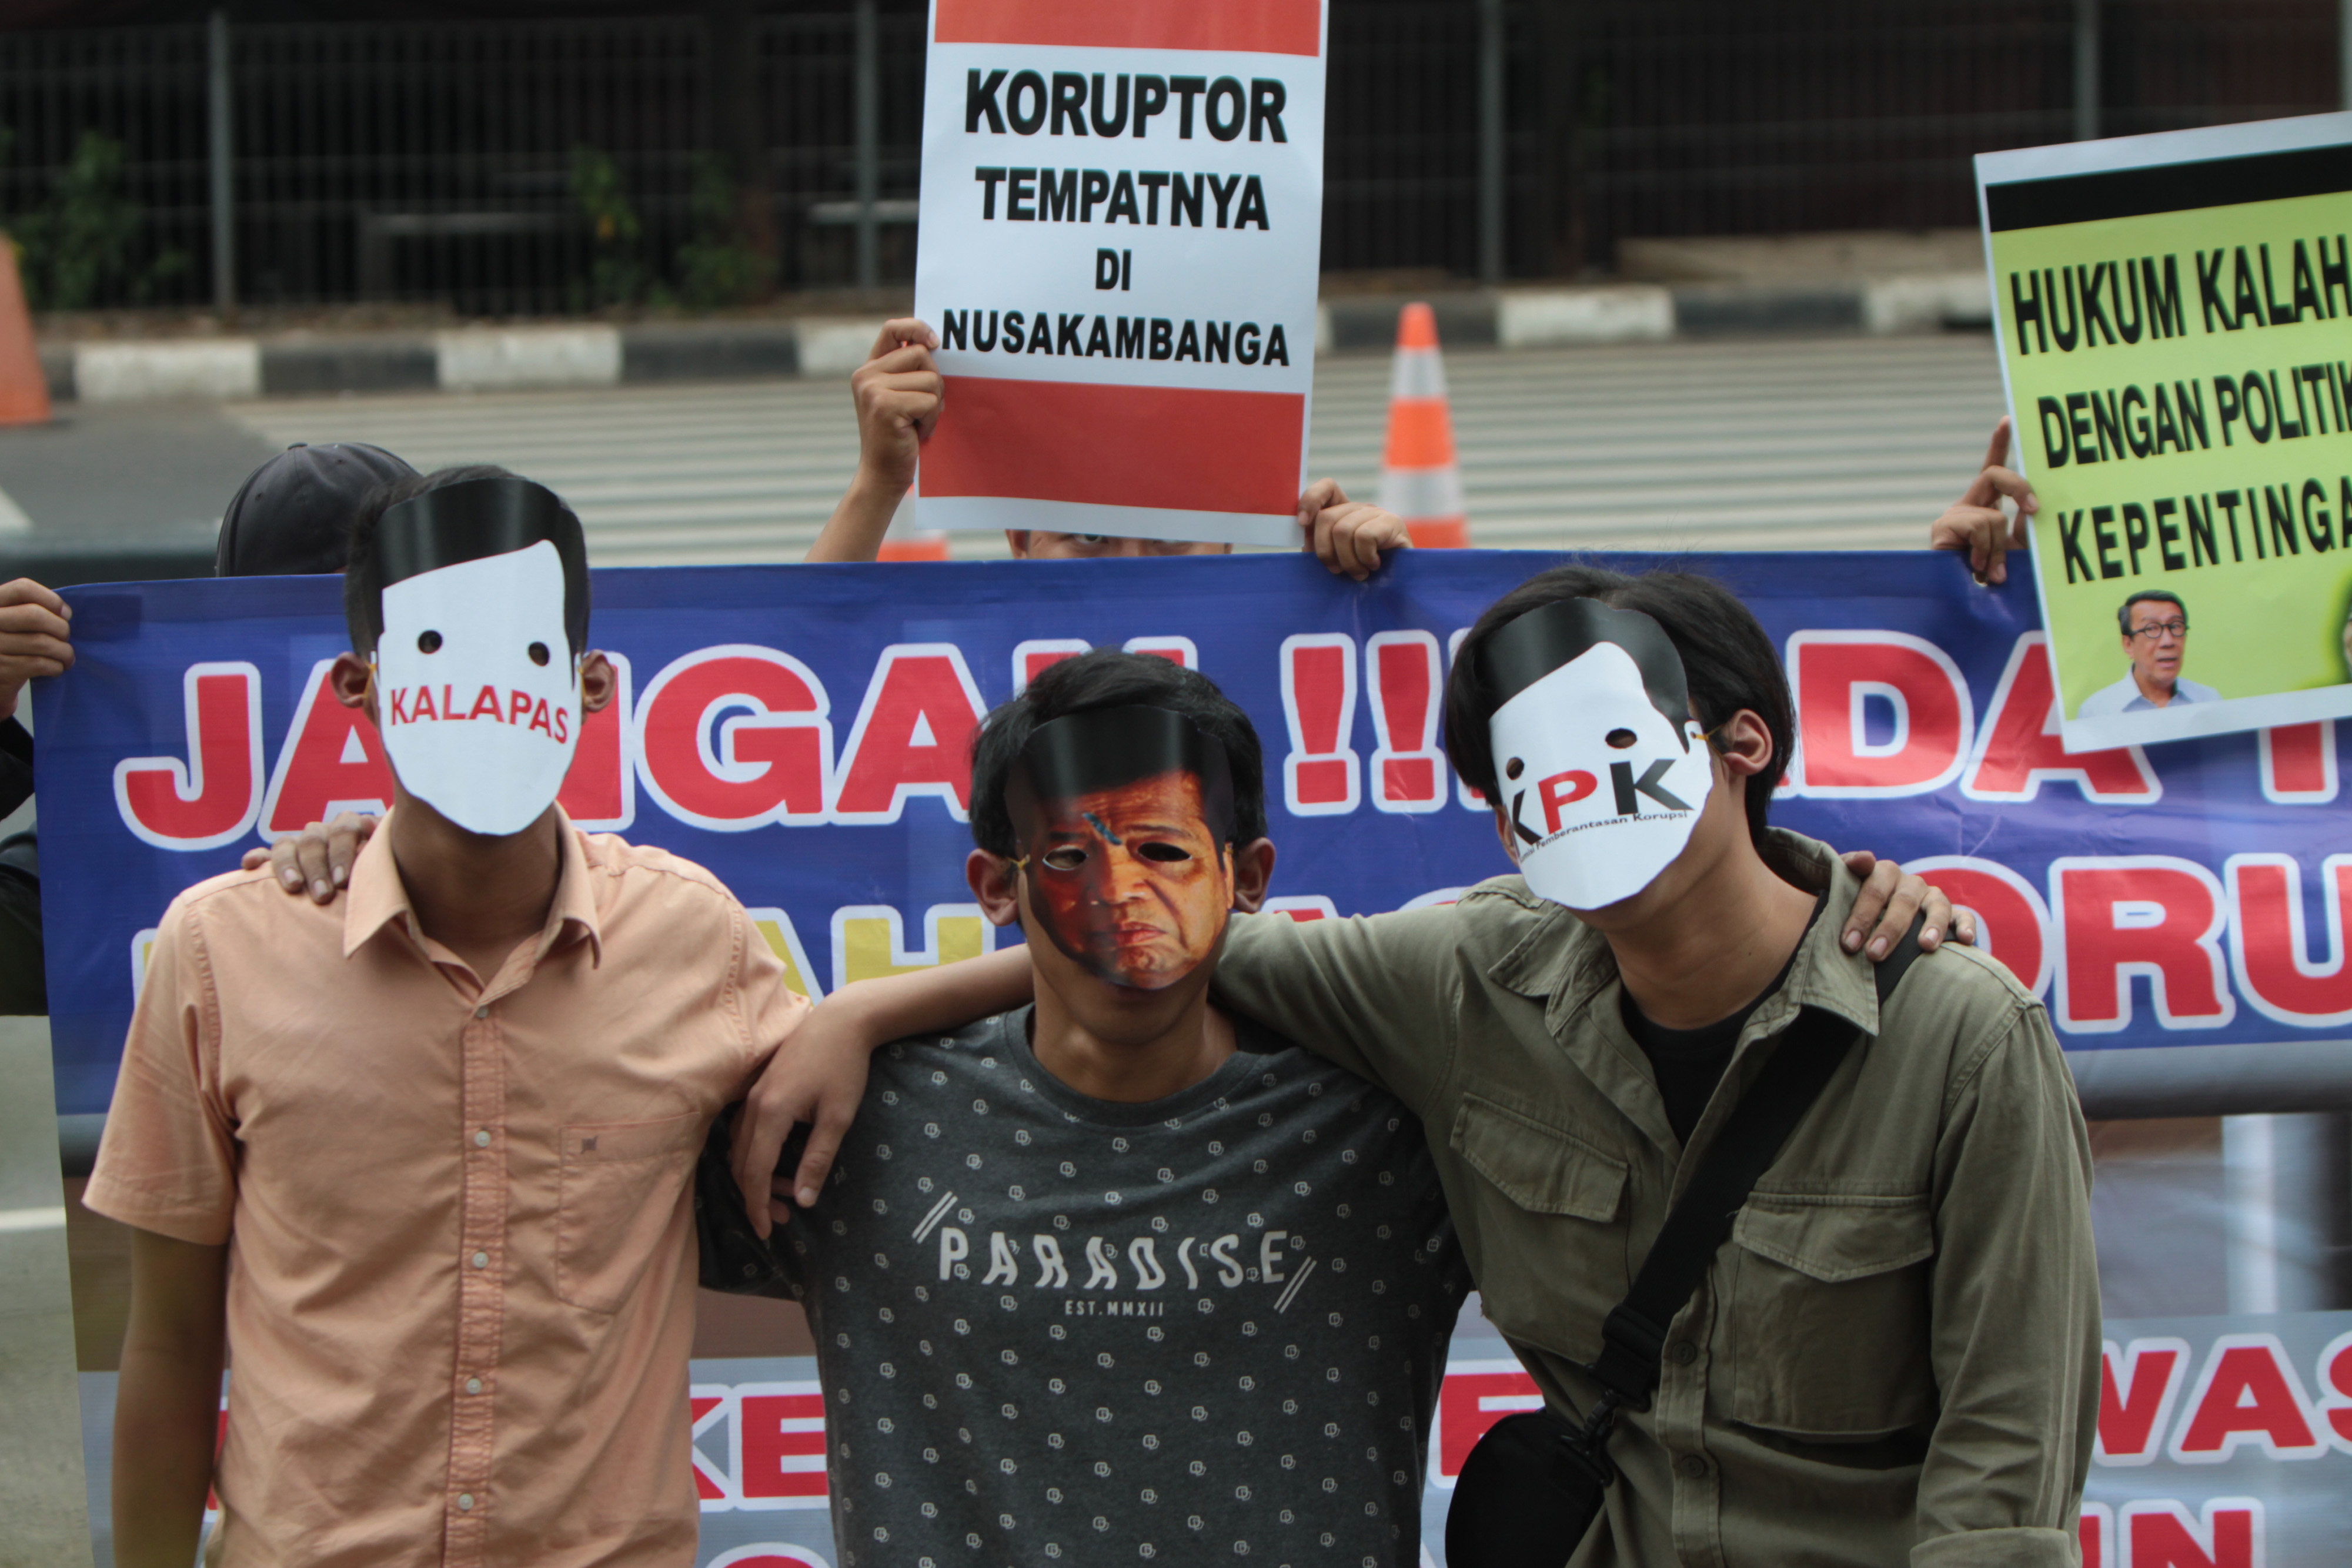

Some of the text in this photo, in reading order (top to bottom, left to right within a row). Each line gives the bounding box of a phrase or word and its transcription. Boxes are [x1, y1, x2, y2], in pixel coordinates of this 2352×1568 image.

[965, 68, 1288, 143] KORUPTOR
[975, 166, 1271, 231] TEMPATNYA
[1095, 248, 1132, 292] DI
[2010, 233, 2352, 355] HUKUM KALAH
[941, 309, 1290, 367] NUSAKAMBANGA
[2037, 377, 2212, 469] DENGAN
[390, 684, 569, 745] KALAPAS
[1536, 817, 1628, 850] Pemberantasan
[1632, 810, 1688, 824] Korupsi
